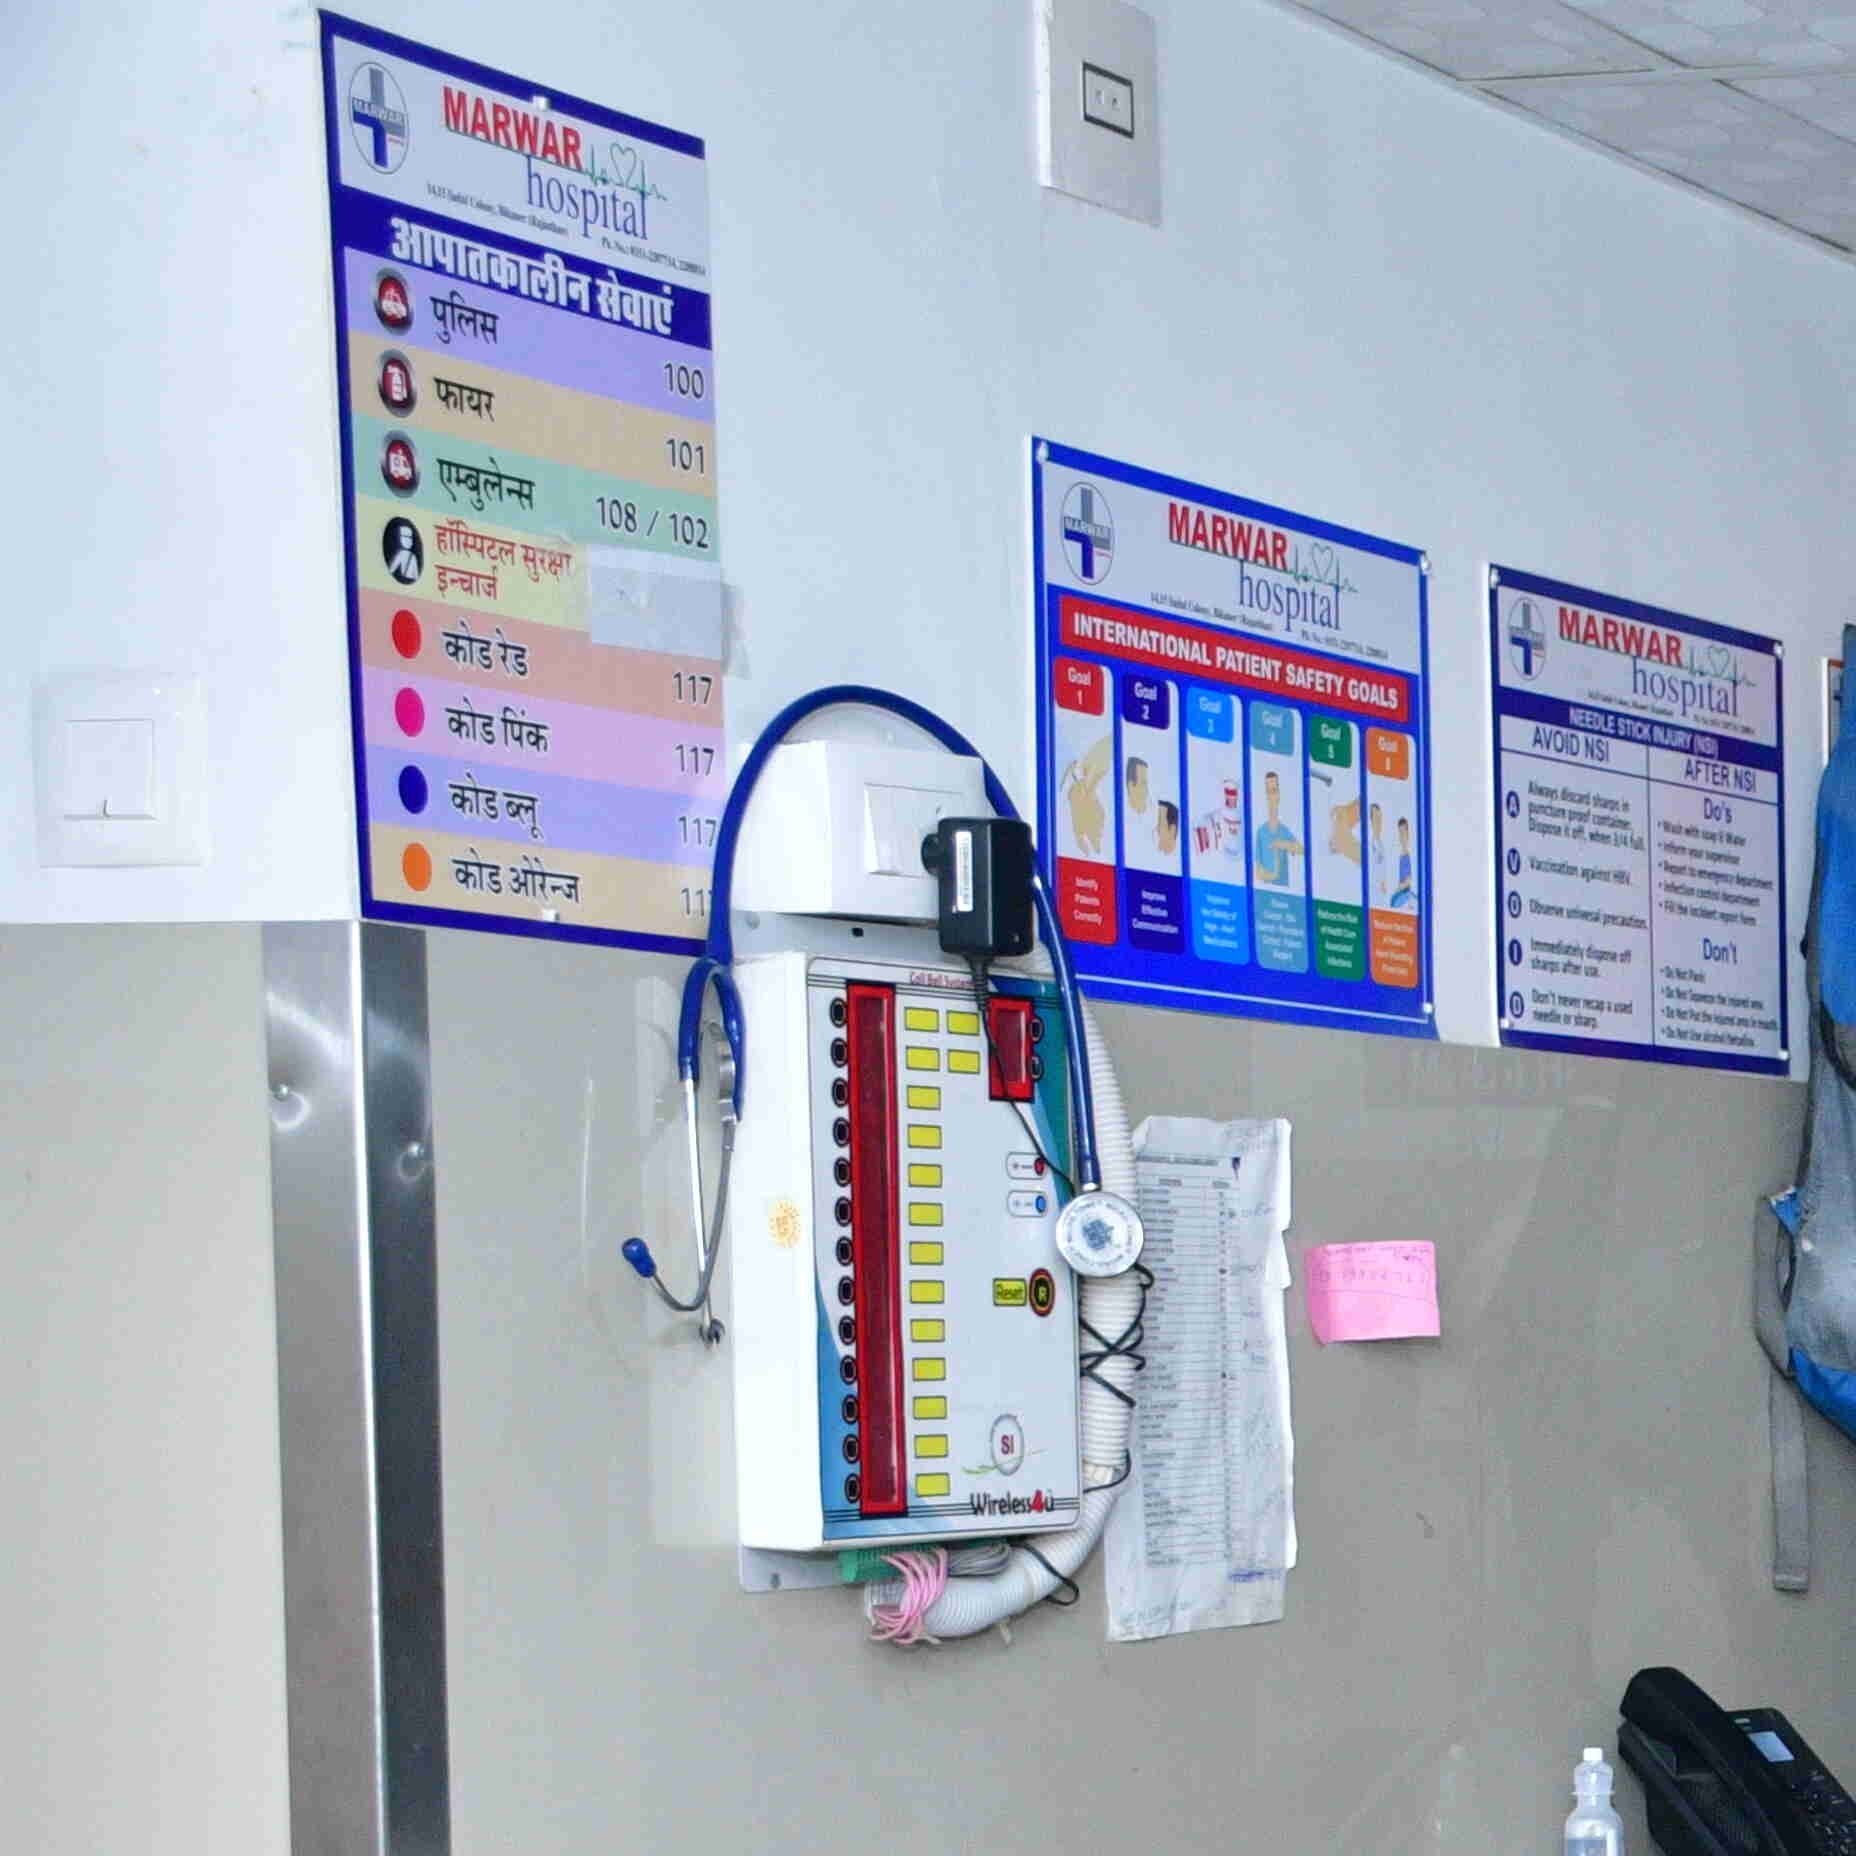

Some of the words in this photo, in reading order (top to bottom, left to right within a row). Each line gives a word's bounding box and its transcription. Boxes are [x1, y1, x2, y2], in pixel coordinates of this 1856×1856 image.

[442, 86, 584, 172] MARWAR
[527, 154, 648, 240] hospital
[390, 217, 591, 313] आपातकालीन
[595, 269, 674, 336] सेवाएं
[430, 291, 498, 345] पुलिस
[433, 376, 495, 421] फायर
[663, 363, 704, 399] 100
[666, 438, 705, 474] 101
[437, 456, 535, 511] एम्बुलेन्स
[596, 497, 637, 534] 108
[670, 513, 709, 549] 102
[1168, 502, 1288, 570] MARWAR
[434, 518, 516, 566] हॉस्पिटल
[520, 542, 573, 583] सुरक्षा
[1238, 561, 1341, 631] hospital
[443, 619, 493, 670] कोड
[497, 628, 528, 676] रेड
[1559, 606, 1682, 669] MARWAR
[1067, 667, 1092, 686] Goal
[1073, 613, 1211, 666] INTERNATIONAL
[1215, 647, 1280, 682] PATIENT
[1285, 658, 1343, 696] SAFETY
[1346, 679, 1399, 709] GOALS
[673, 672, 712, 705] 117
[1134, 682, 1158, 700] Goal
[1632, 656, 1738, 717] hospital
[445, 698, 494, 745] कोड
[501, 707, 549, 753] पिंक
[1532, 726, 1580, 758] AVOID
[1584, 740, 1610, 762] NSI
[1569, 707, 1615, 735] NEEDLE
[1617, 721, 1651, 746] STICK
[1652, 727, 1692, 749] INJURY
[675, 743, 714, 775] 117
[1685, 759, 1730, 785] AFTER
[1734, 769, 1757, 793] NSI
[449, 772, 499, 820] कोड
[504, 791, 542, 839] ब्लू
[1704, 797, 1732, 824] Do's
[678, 816, 717, 847] 117
[452, 848, 502, 894] कोड
[681, 887, 712, 917] 11
[1703, 937, 1737, 965] Don't
[1001, 1434, 1014, 1455] SI
